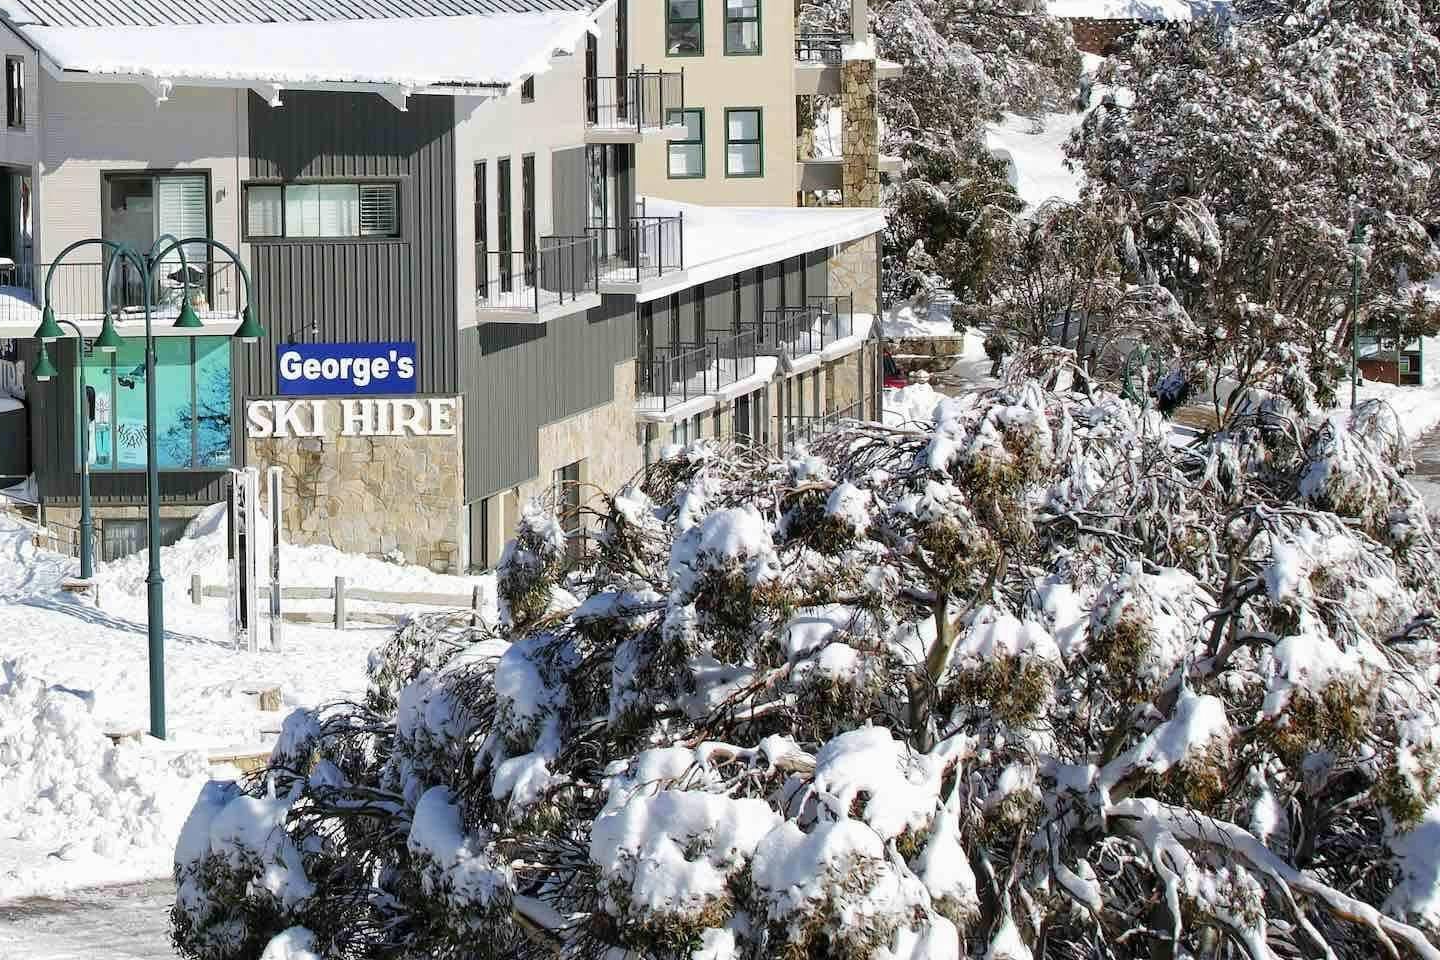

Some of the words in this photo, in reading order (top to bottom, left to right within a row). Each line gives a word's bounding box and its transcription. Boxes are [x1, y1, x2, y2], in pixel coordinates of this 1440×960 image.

[279, 350, 414, 387] George's
[247, 399, 326, 438] SKI
[340, 398, 457, 438] HIRE
